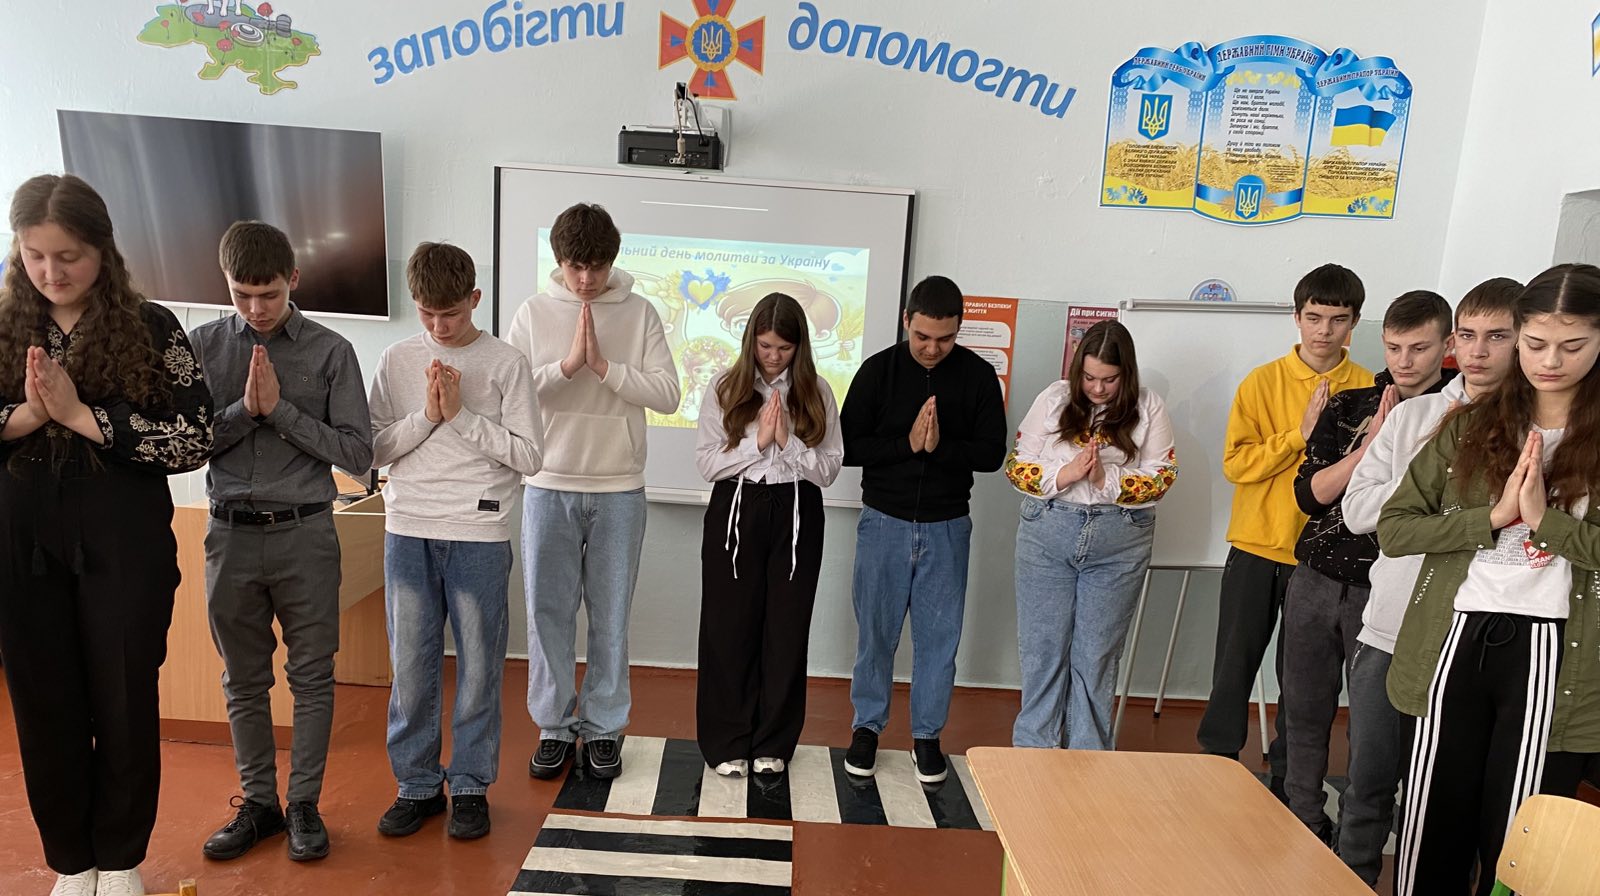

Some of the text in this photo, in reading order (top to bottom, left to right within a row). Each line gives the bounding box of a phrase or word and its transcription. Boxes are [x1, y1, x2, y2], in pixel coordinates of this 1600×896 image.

[368, 0, 625, 85] запобігти
[788, 1, 1077, 119] допомогти
[1217, 42, 1319, 66] ДЕРЖАВНИЙ ГІМН УКРАЇНИ
[660, 246, 692, 260] день
[694, 251, 758, 264] молитви
[760, 255, 776, 265] за
[780, 254, 830, 270] Україну
